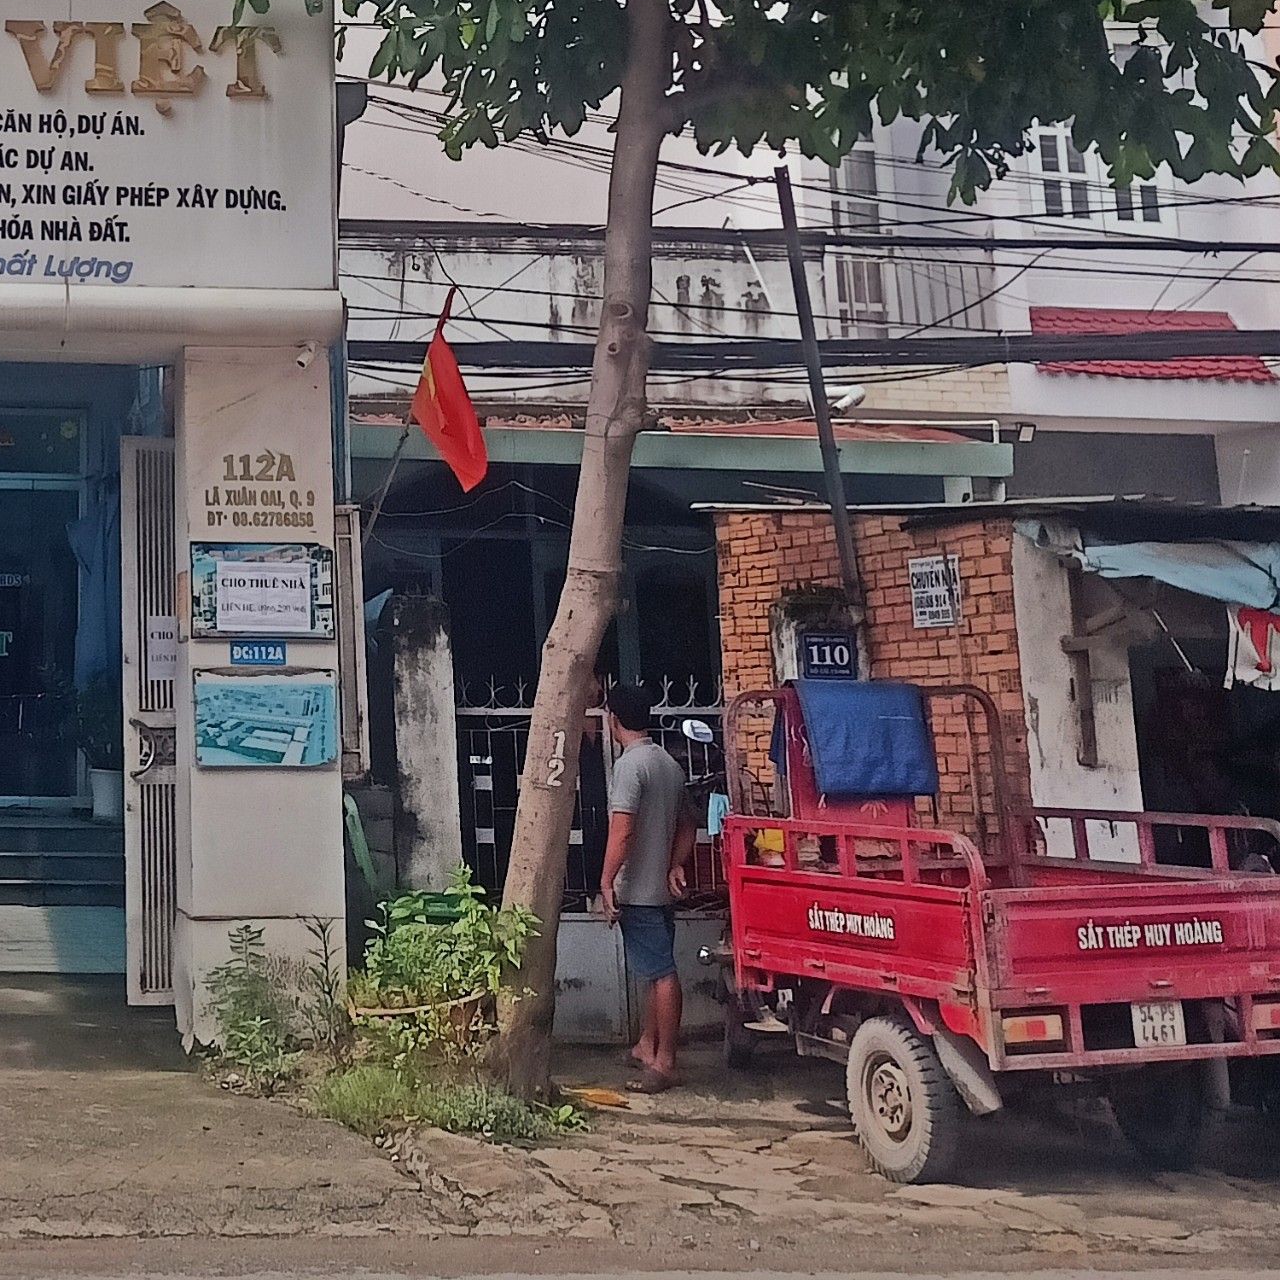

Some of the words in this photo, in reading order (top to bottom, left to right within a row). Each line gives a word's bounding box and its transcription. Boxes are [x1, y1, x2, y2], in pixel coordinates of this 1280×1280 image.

[5, 0, 283, 116] VIỆT
[38, 109, 75, 139] HỘ,
[77, 111, 108, 140] DỰ
[110, 110, 145, 136] ÁN.
[26, 146, 55, 174] DỰ
[21, 184, 56, 205] XIN
[62, 179, 109, 206] GIẤY
[116, 182, 170, 207] PHÉP
[176, 184, 219, 208] XÂY
[225, 185, 287, 214] DỰNG.
[41, 216, 83, 242] NHÀ
[89, 215, 130, 243] ĐẤT.
[44, 254, 134, 284] Lượng
[223, 454, 296, 482] 112A
[205, 486, 221, 506] LÃ
[224, 486, 257, 506] XUÂN
[260, 490, 286, 509] OAI,
[289, 490, 302, 509] Q.
[306, 490, 316, 506] 9
[221, 578, 247, 588] CHO
[248, 576, 279, 589] THUÊ
[281, 576, 306, 590] NHÀ
[150, 631, 174, 641] CHO
[232, 645, 283, 661] ĐC:112A
[809, 644, 850, 666] 110
[1077, 919, 1104, 949] SẮT
[1106, 920, 1141, 948] THÉP
[1144, 923, 1171, 947] HUY
[1174, 917, 1223, 945] HOÀNG
[1142, 1024, 1177, 1043] 4461
